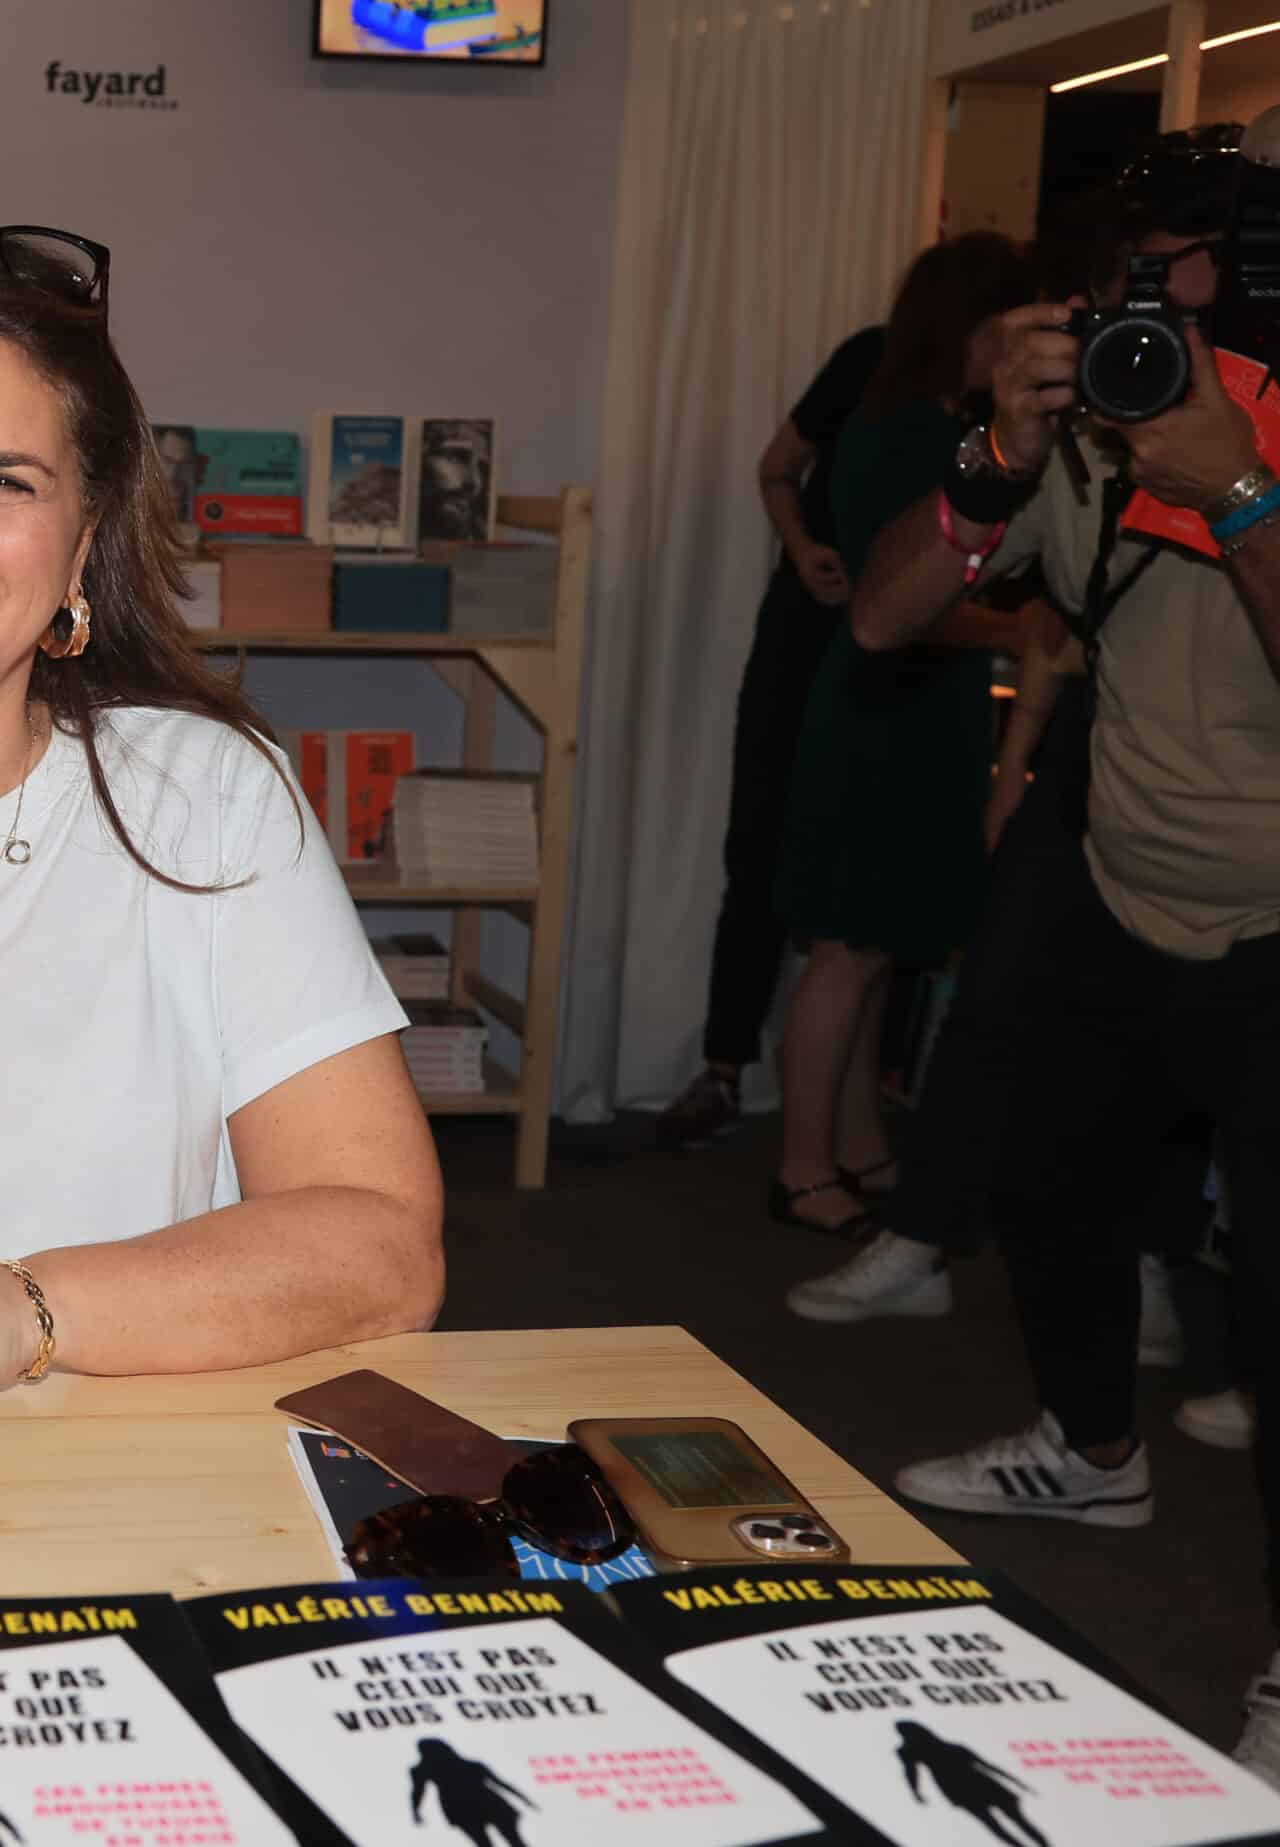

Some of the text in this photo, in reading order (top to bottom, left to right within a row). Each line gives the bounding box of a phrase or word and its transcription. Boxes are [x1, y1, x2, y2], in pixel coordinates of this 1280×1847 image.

[44, 60, 167, 103] fayard
[664, 1575, 994, 1611] VALÉRIE BENAÏM
[222, 1590, 565, 1632] VALÉRIE BENAÏM
[765, 1631, 1007, 1662] IL N'EST PAS
[29, 1668, 106, 1691] PAS
[311, 1647, 556, 1680] IL N'EST PAS
[815, 1656, 1007, 1685] CELUI QUE
[353, 1671, 548, 1702] CELUI QUE
[804, 1678, 1070, 1713] VOUS CROYEZ
[13, 1694, 85, 1719] QUE
[334, 1692, 607, 1733] VOUS CROYEZ
